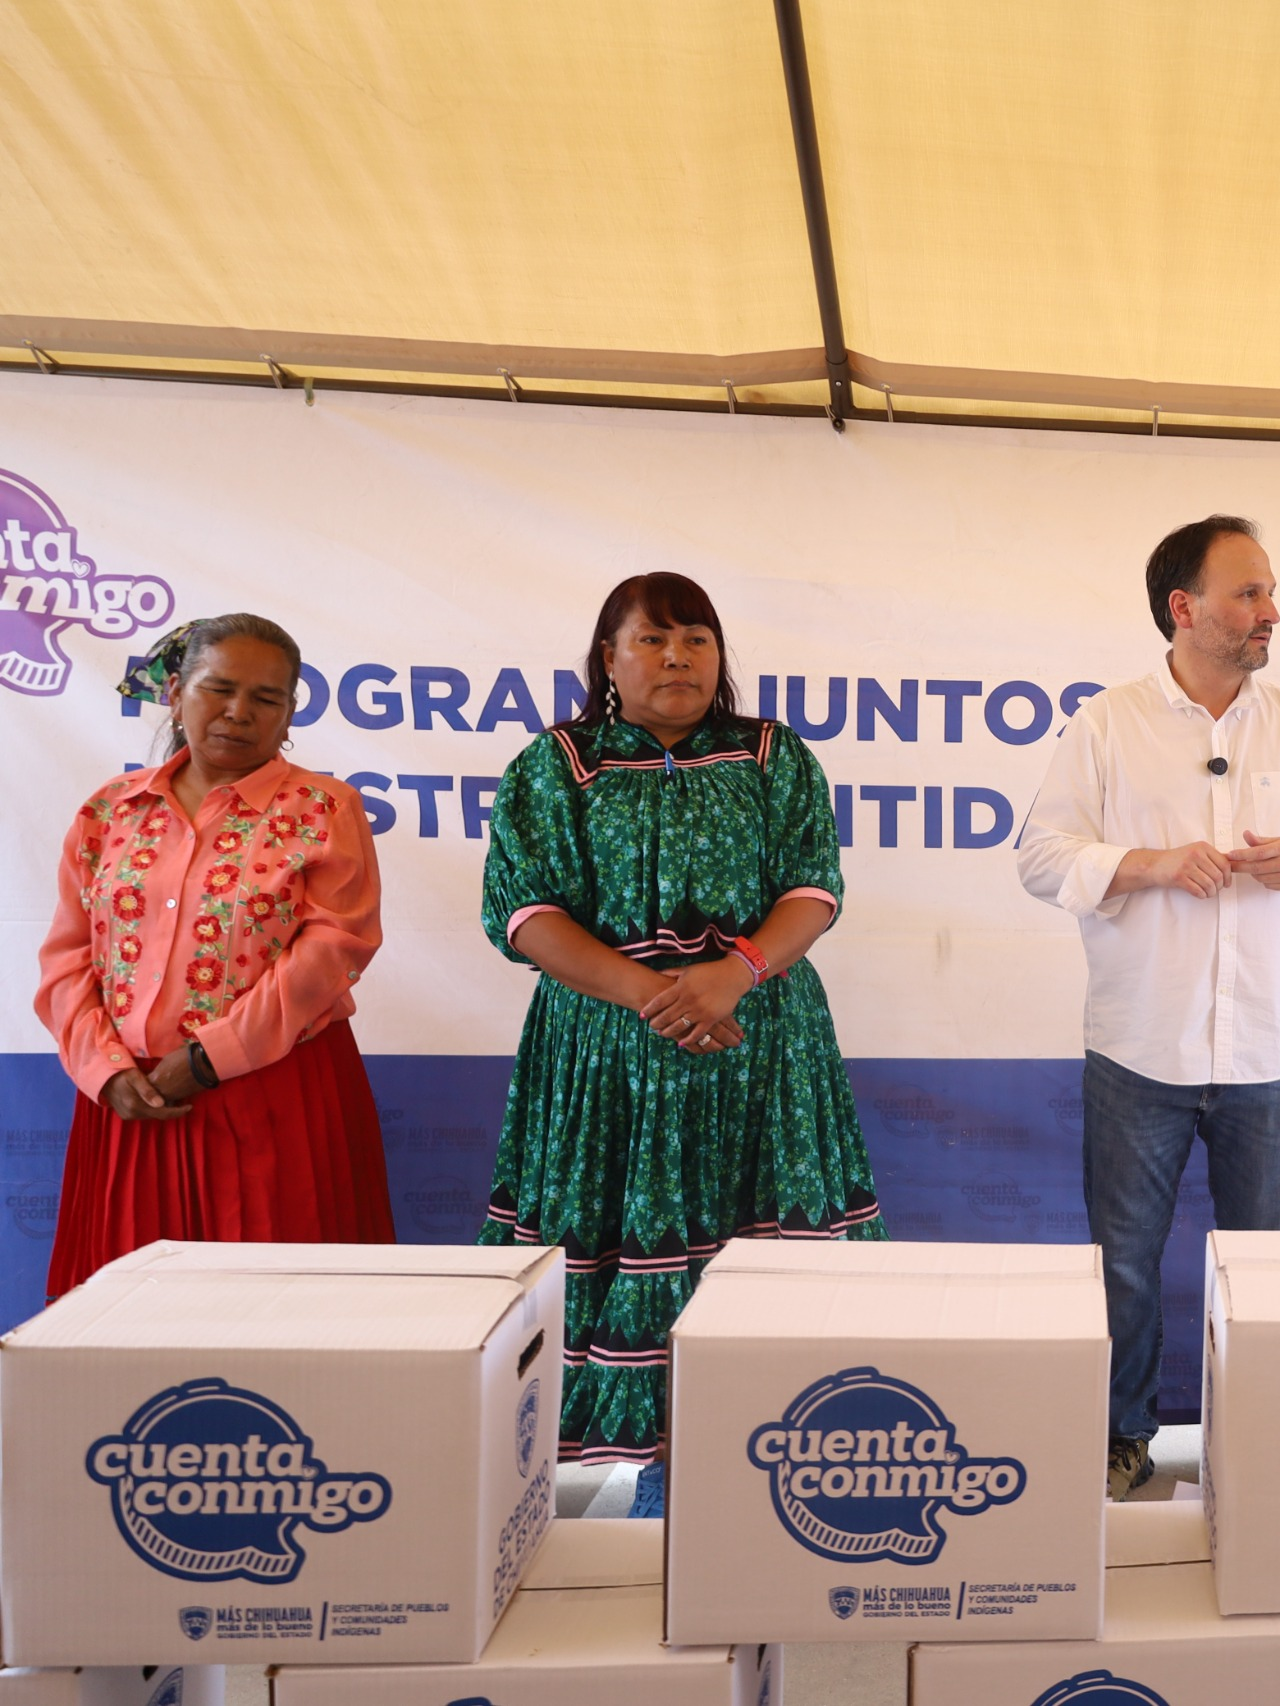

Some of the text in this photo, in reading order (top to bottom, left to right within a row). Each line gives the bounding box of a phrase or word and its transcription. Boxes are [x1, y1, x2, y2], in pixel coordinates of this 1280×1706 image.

[6, 1193, 59, 1207] cuent
[755, 1421, 948, 1463] cuenta
[94, 1434, 304, 1477] cuenta
[790, 1464, 1019, 1508] conmigo
[132, 1480, 384, 1525] conmigo
[863, 1585, 950, 1602] MÁS CHIHUAHUA
[969, 1583, 1019, 1592] SECRETARÍA
[1037, 1583, 1076, 1592] PUEBLOS
[863, 1601, 885, 1610] más
[918, 1601, 951, 1610] bueno
[976, 1595, 1038, 1604] COMUNIDADES
[967, 1606, 1014, 1615] INDÍGENAS
